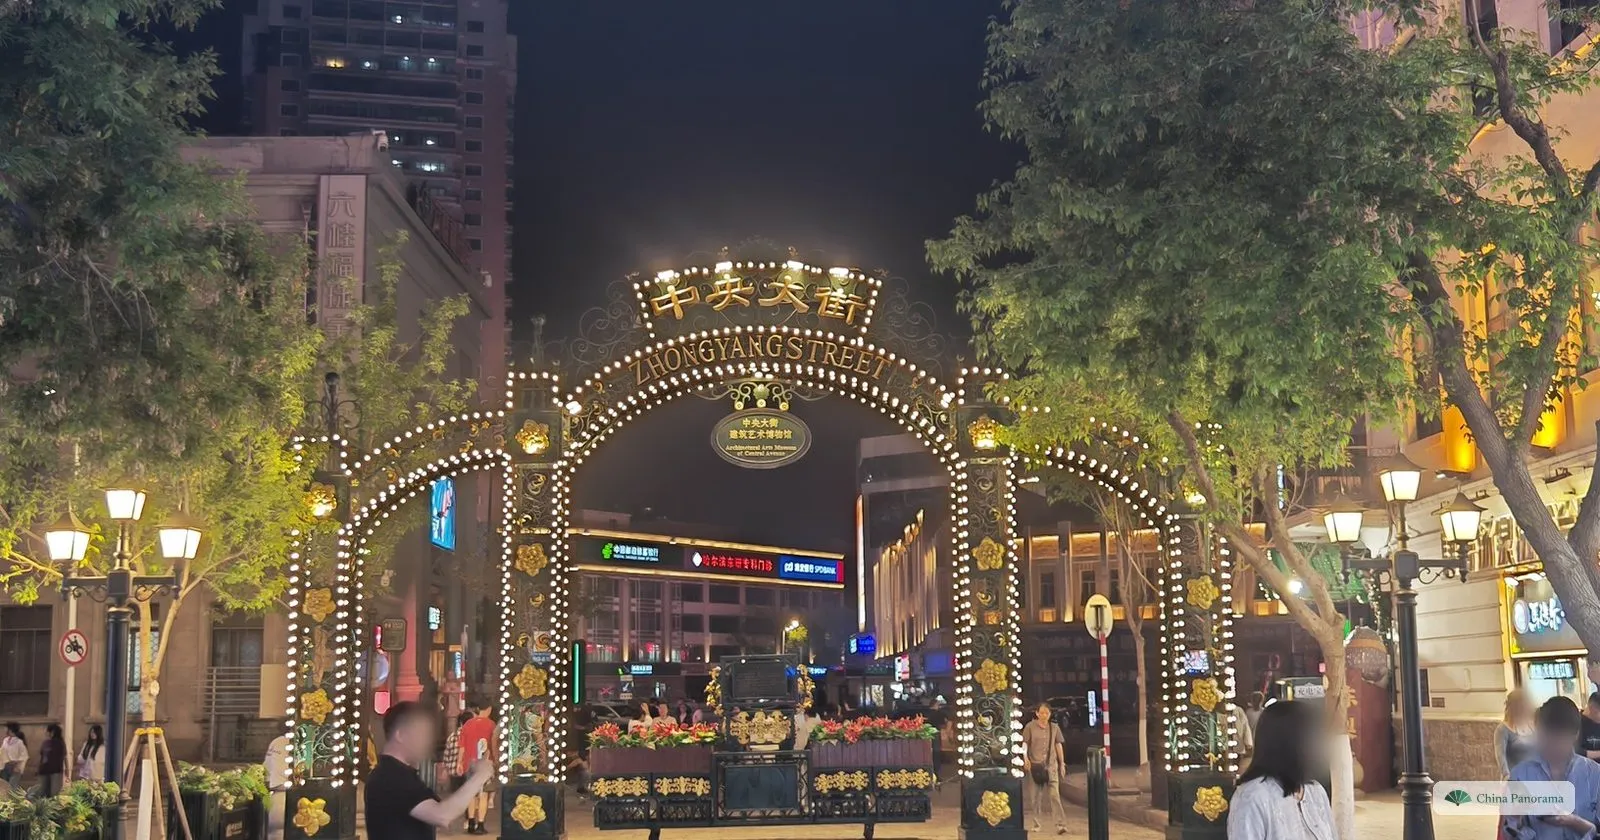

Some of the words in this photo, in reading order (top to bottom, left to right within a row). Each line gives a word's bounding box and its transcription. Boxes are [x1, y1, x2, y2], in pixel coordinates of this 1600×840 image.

[651, 275, 866, 324] 中央大街
[742, 418, 779, 428] 中央大街
[729, 430, 792, 439] 建筑艺术博物馆
